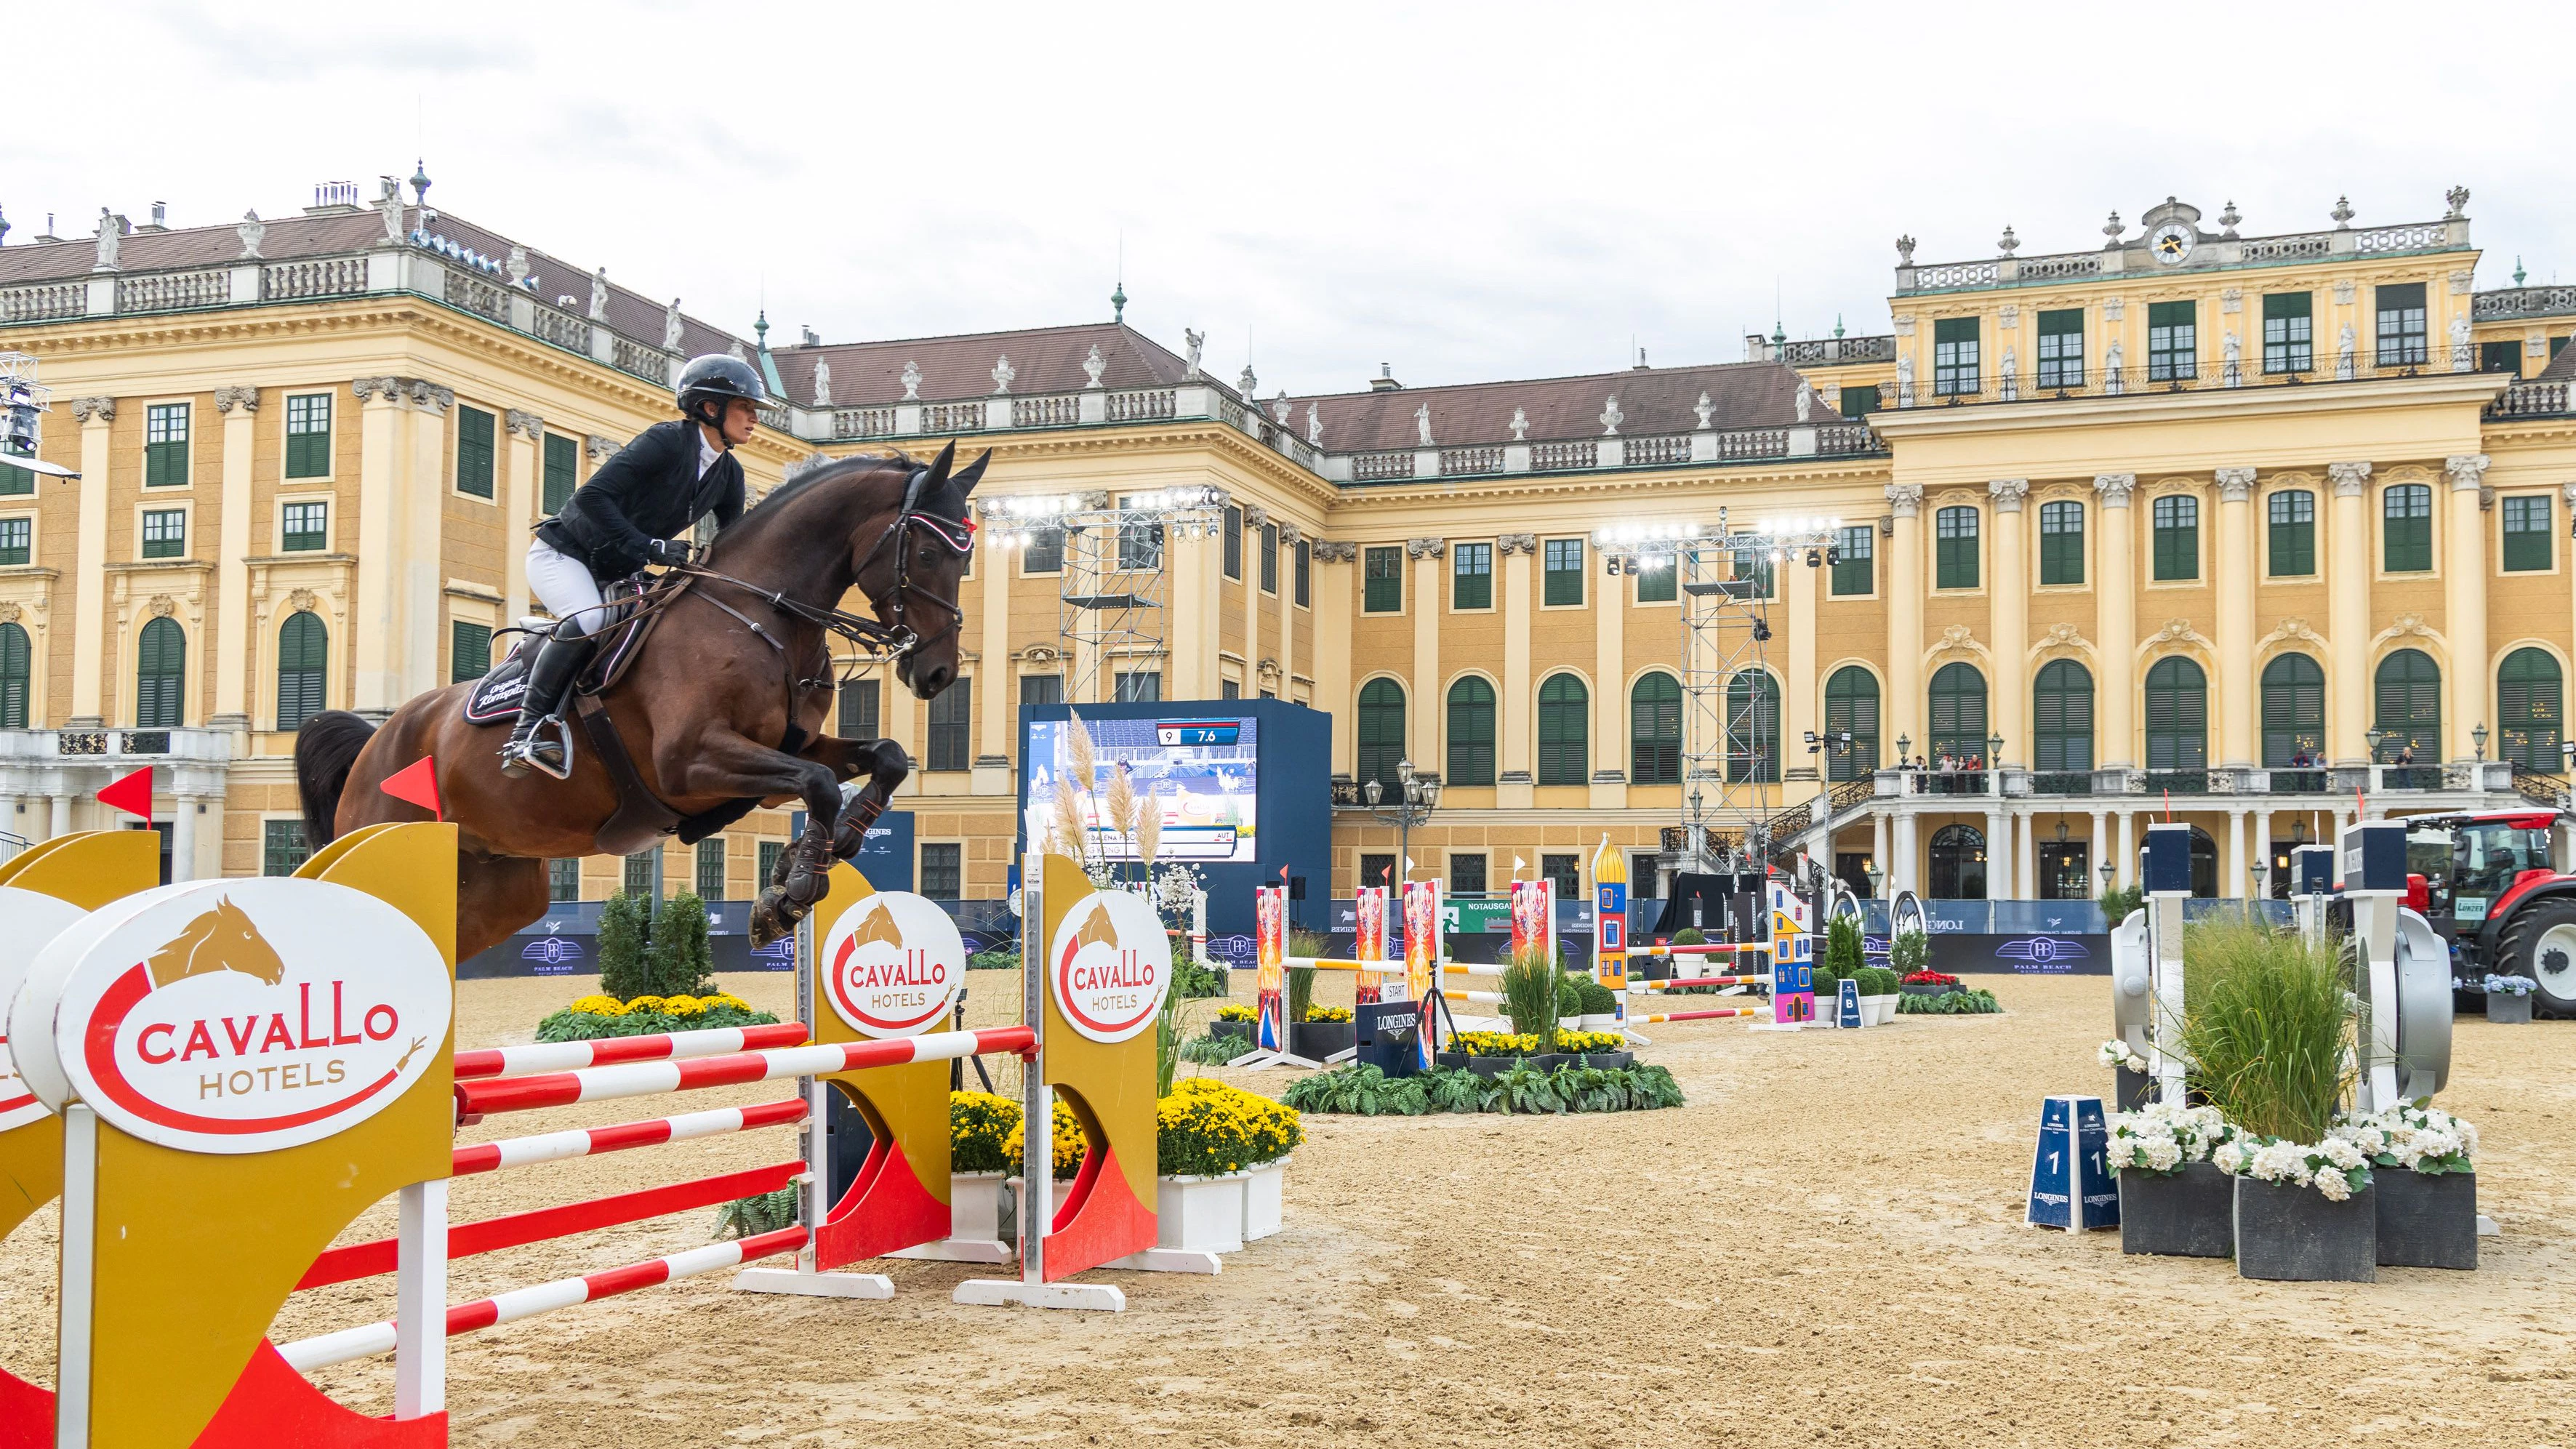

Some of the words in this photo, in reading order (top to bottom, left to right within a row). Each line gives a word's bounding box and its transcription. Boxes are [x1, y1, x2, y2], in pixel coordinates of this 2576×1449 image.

[1165, 731, 1173, 742] 9
[1197, 730, 1216, 742] 7.6
[850, 949, 945, 988] CAVALLO
[1074, 949, 1155, 990] CAVALLO
[872, 991, 926, 1008] HOTELS
[1389, 984, 1405, 998] START
[1092, 994, 1137, 1011] HOTELS
[1846, 999, 1853, 1008] B
[137, 980, 398, 1064] CAVALLO
[1377, 1013, 1416, 1030] LONGINES
[198, 1059, 345, 1100] HOTELS
[2049, 1151, 2059, 1175] 1
[2091, 1151, 2102, 1175] 1
[2034, 1192, 2069, 1203] LONGINES
[2084, 1193, 2117, 1204] LONGINES
